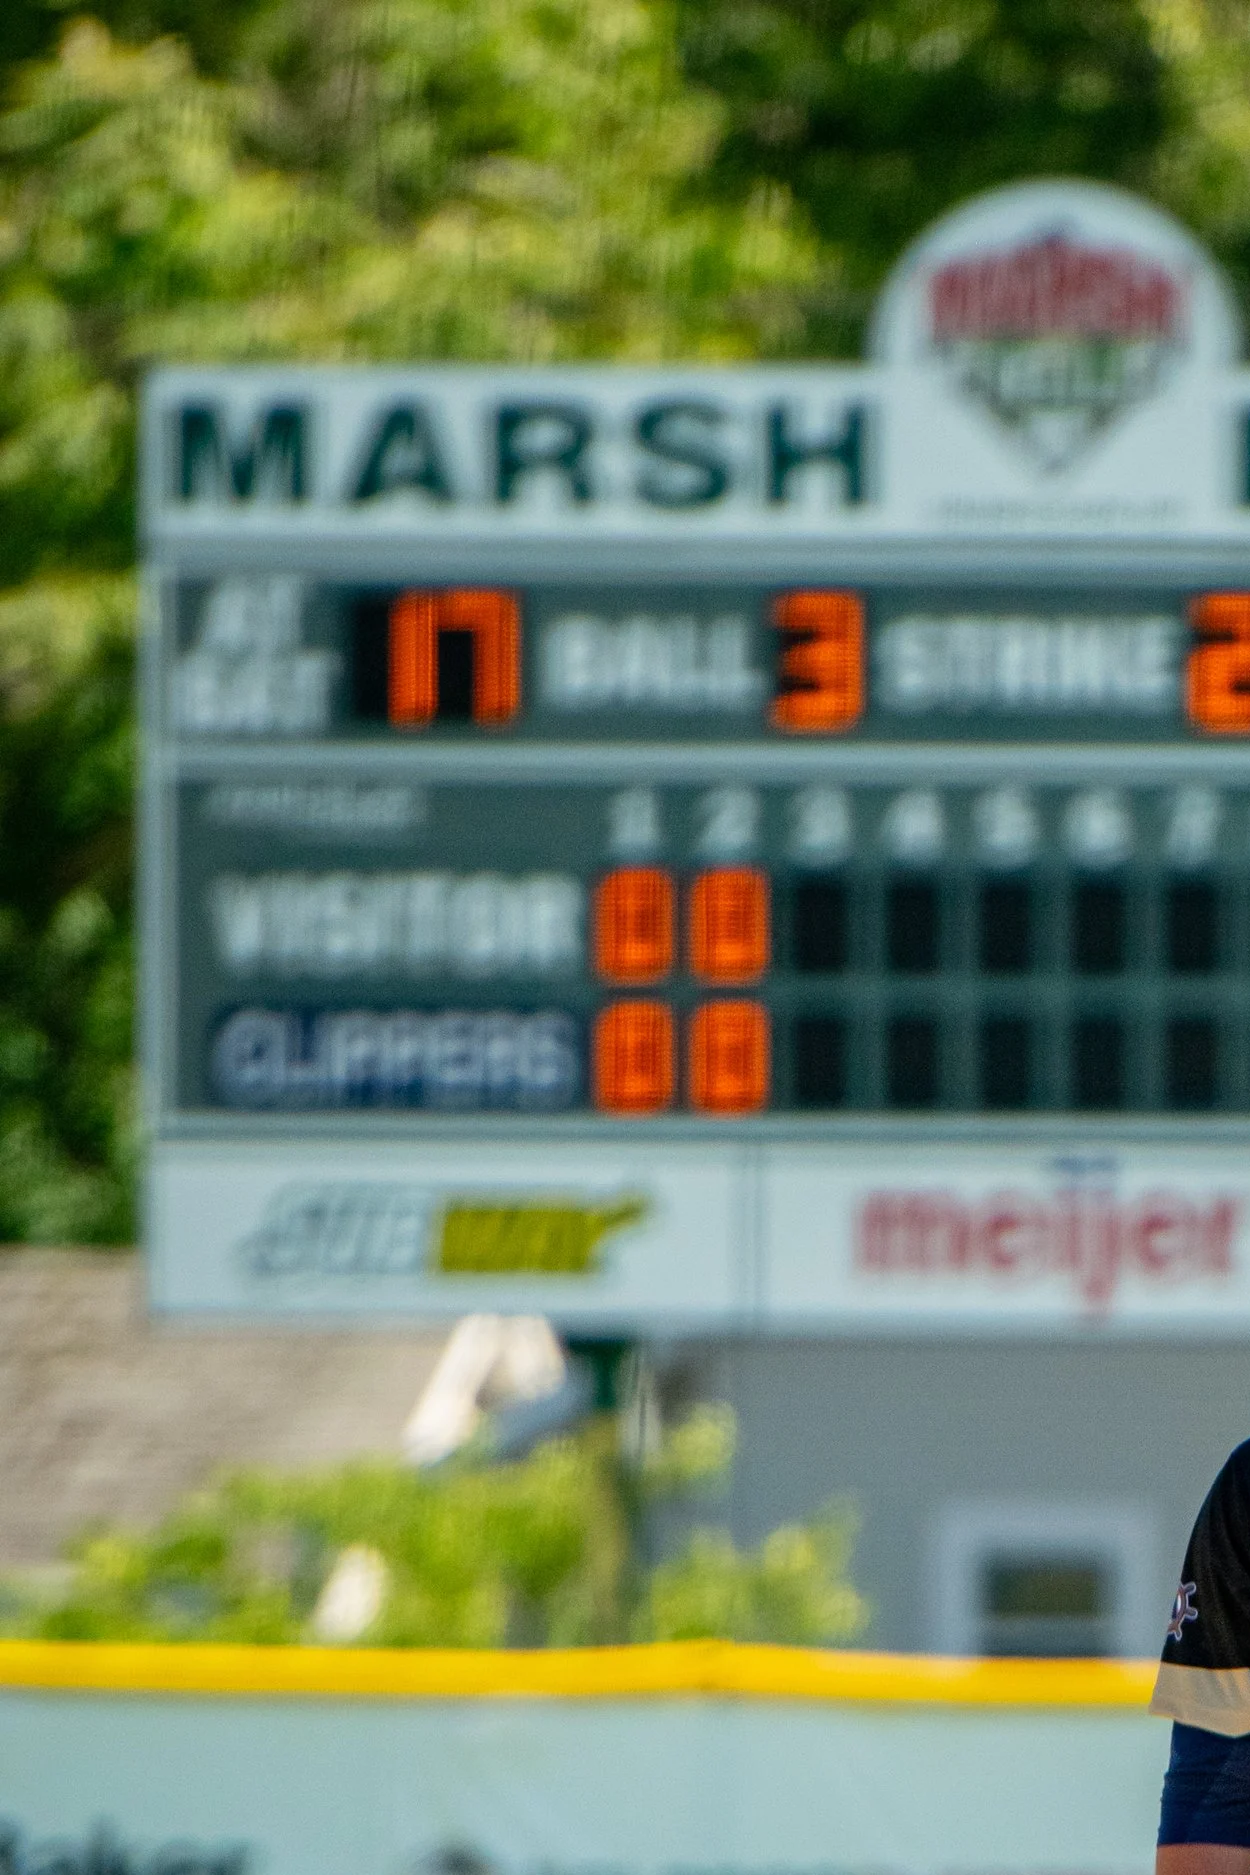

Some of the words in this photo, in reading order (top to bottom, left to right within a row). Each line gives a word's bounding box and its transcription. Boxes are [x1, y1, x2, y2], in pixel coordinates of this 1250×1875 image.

[175, 400, 872, 508] MARSH
[544, 616, 762, 708] BALL
[772, 590, 866, 733] 3
[880, 616, 1178, 712] STRIKE
[612, 789, 658, 856] 1
[700, 787, 758, 856] 2
[215, 873, 583, 972] VISITOR
[596, 866, 676, 987] 0
[688, 866, 770, 987] 0
[217, 1014, 577, 1097] CLIPPERS
[596, 998, 676, 1116] 0
[688, 998, 770, 1116] 0
[860, 1178, 1248, 1305] meijer
